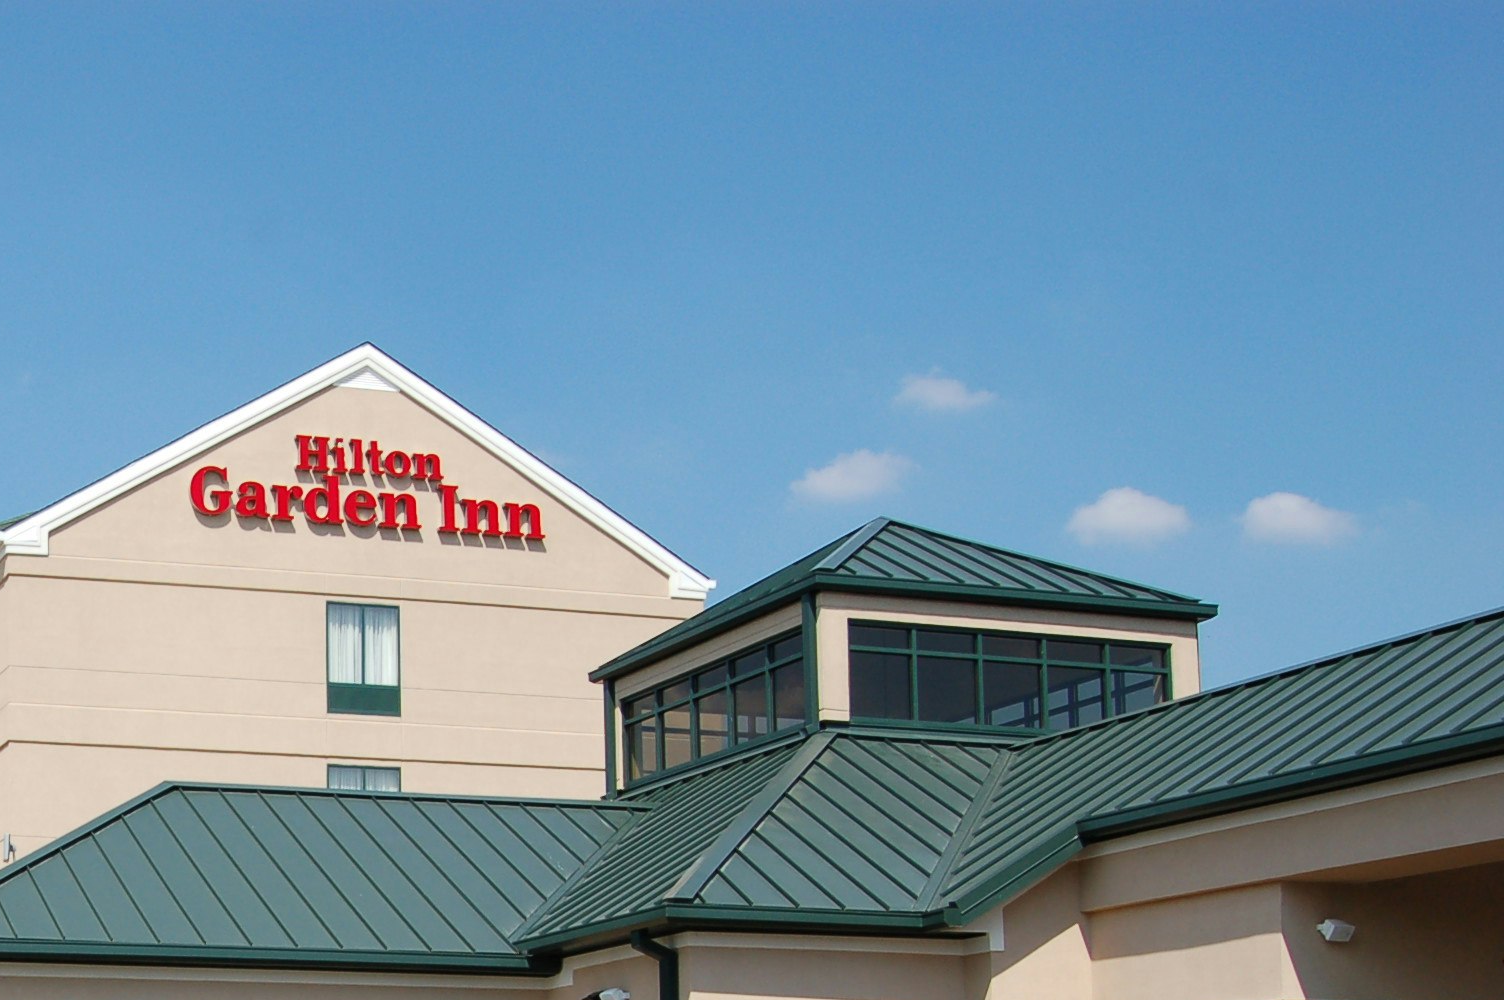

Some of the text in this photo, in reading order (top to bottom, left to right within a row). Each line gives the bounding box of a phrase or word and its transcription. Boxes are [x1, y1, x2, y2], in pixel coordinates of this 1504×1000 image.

[295, 433, 444, 481] Hilton
[190, 465, 546, 540] Garden Inn
